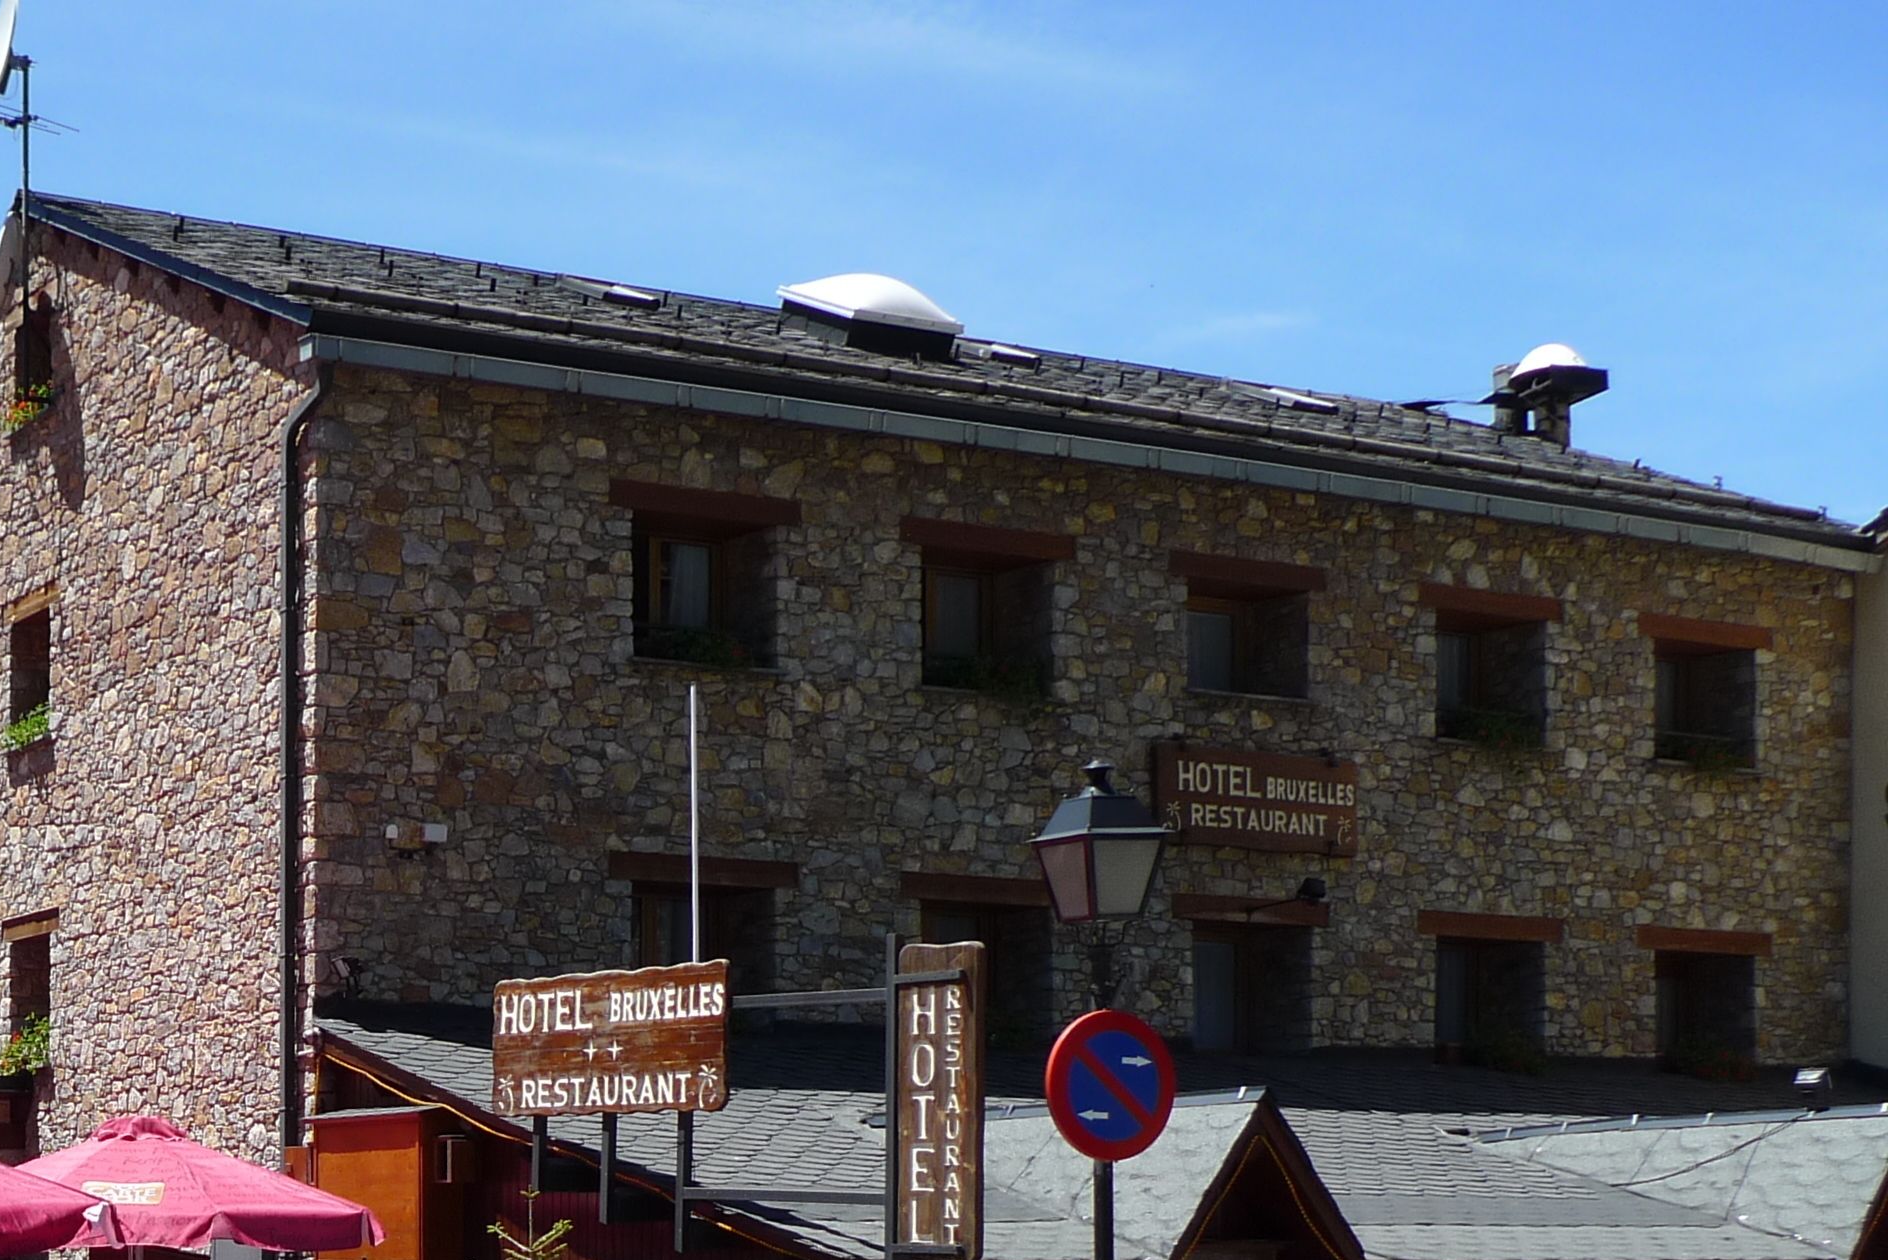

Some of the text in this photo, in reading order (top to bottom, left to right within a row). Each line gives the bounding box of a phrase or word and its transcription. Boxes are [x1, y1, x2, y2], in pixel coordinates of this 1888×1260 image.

[1178, 760, 1355, 807] HOTEL BRUXELLES
[1191, 802, 1328, 836] RESTAURANT
[499, 982, 724, 1035] HOTEL BRUXELLES
[521, 1070, 694, 1109] RESTAURANT
[911, 994, 936, 1244] HOTEL
[944, 986, 961, 1245] RESTAURANT
[87, 1185, 157, 1198] CARTE
